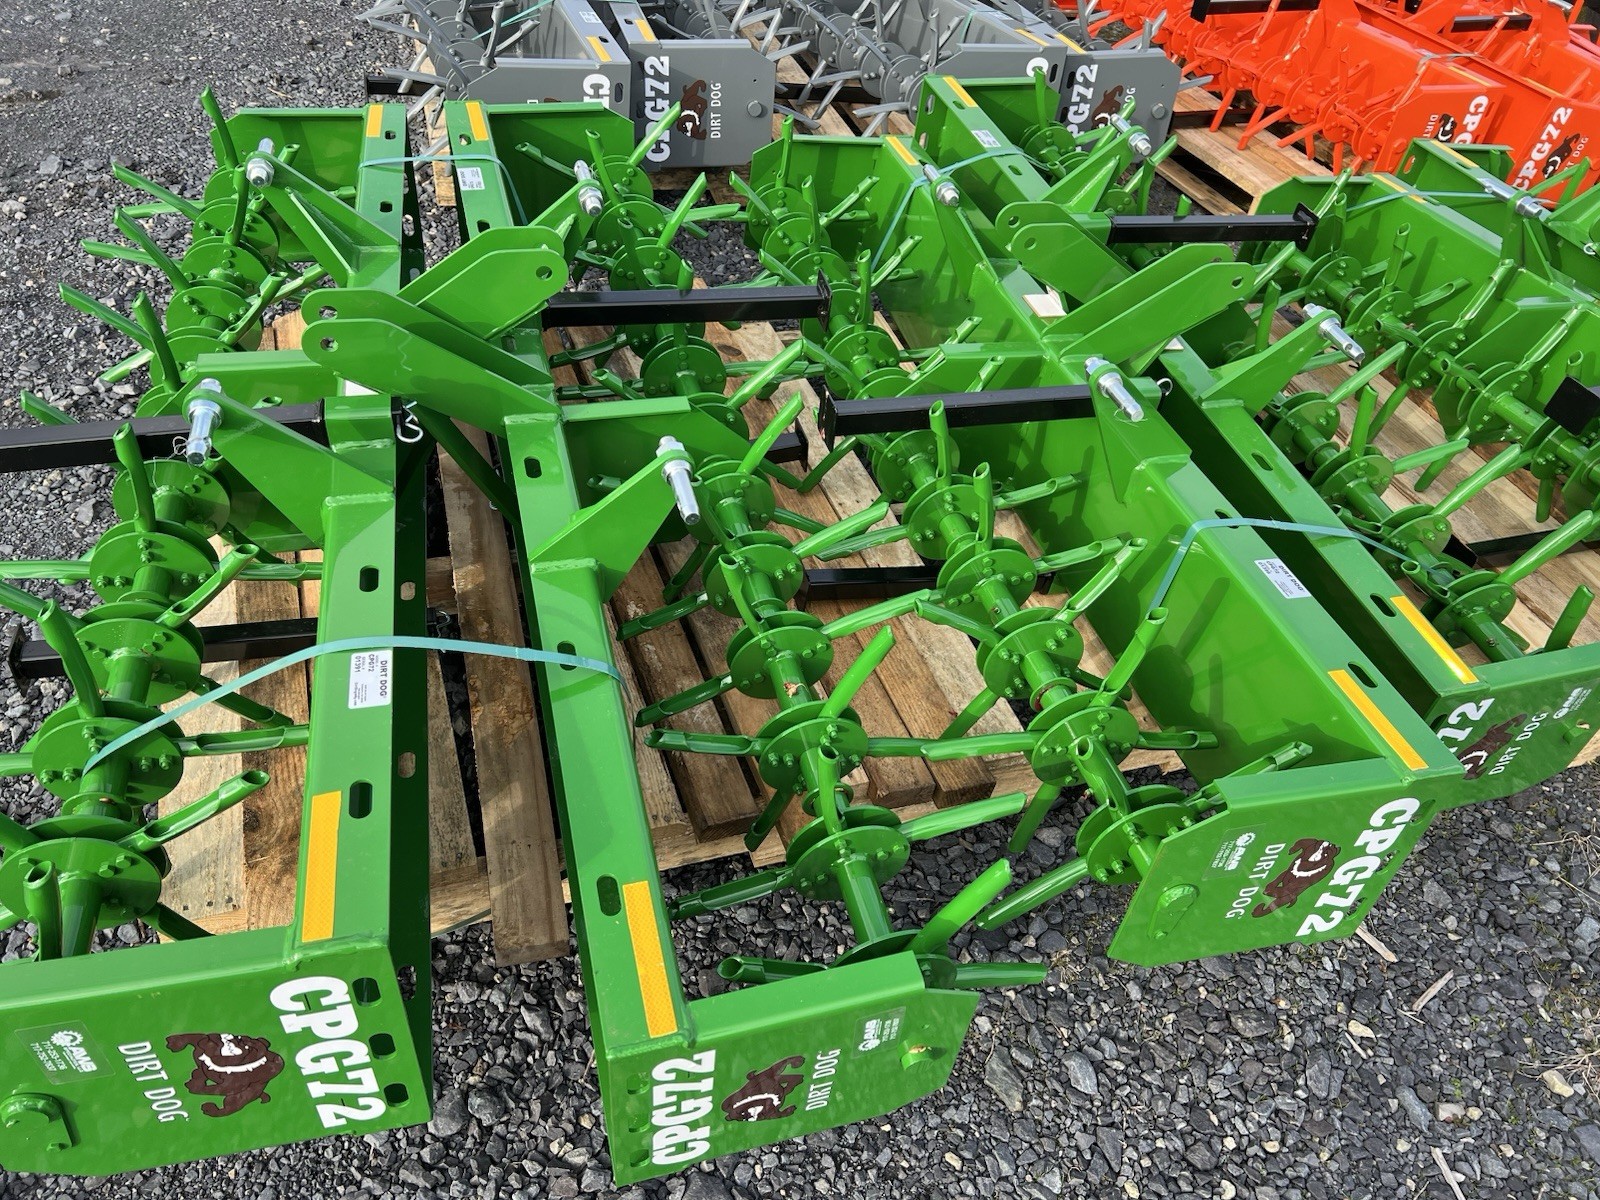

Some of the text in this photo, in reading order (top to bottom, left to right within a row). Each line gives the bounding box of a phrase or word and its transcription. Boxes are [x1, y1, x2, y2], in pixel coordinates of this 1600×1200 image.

[711, 83, 721, 138] DIRT DOG
[1067, 64, 1099, 140] G72
[1512, 106, 1573, 191] CPG72
[1278, 565, 1293, 578] DIRT
[1290, 578, 1304, 591] DOG
[380, 660, 388, 697] DIRT DOG
[1488, 712, 1549, 775] DIRT DOG
[1224, 842, 1286, 920] DIRT DOG
[1295, 797, 1421, 937] CPG72
[117, 1041, 188, 1123] DIRT DOG
[269, 976, 387, 1129] CPG72
[805, 1049, 841, 1111] DIRT DOG
[651, 1049, 716, 1165] CPG72
